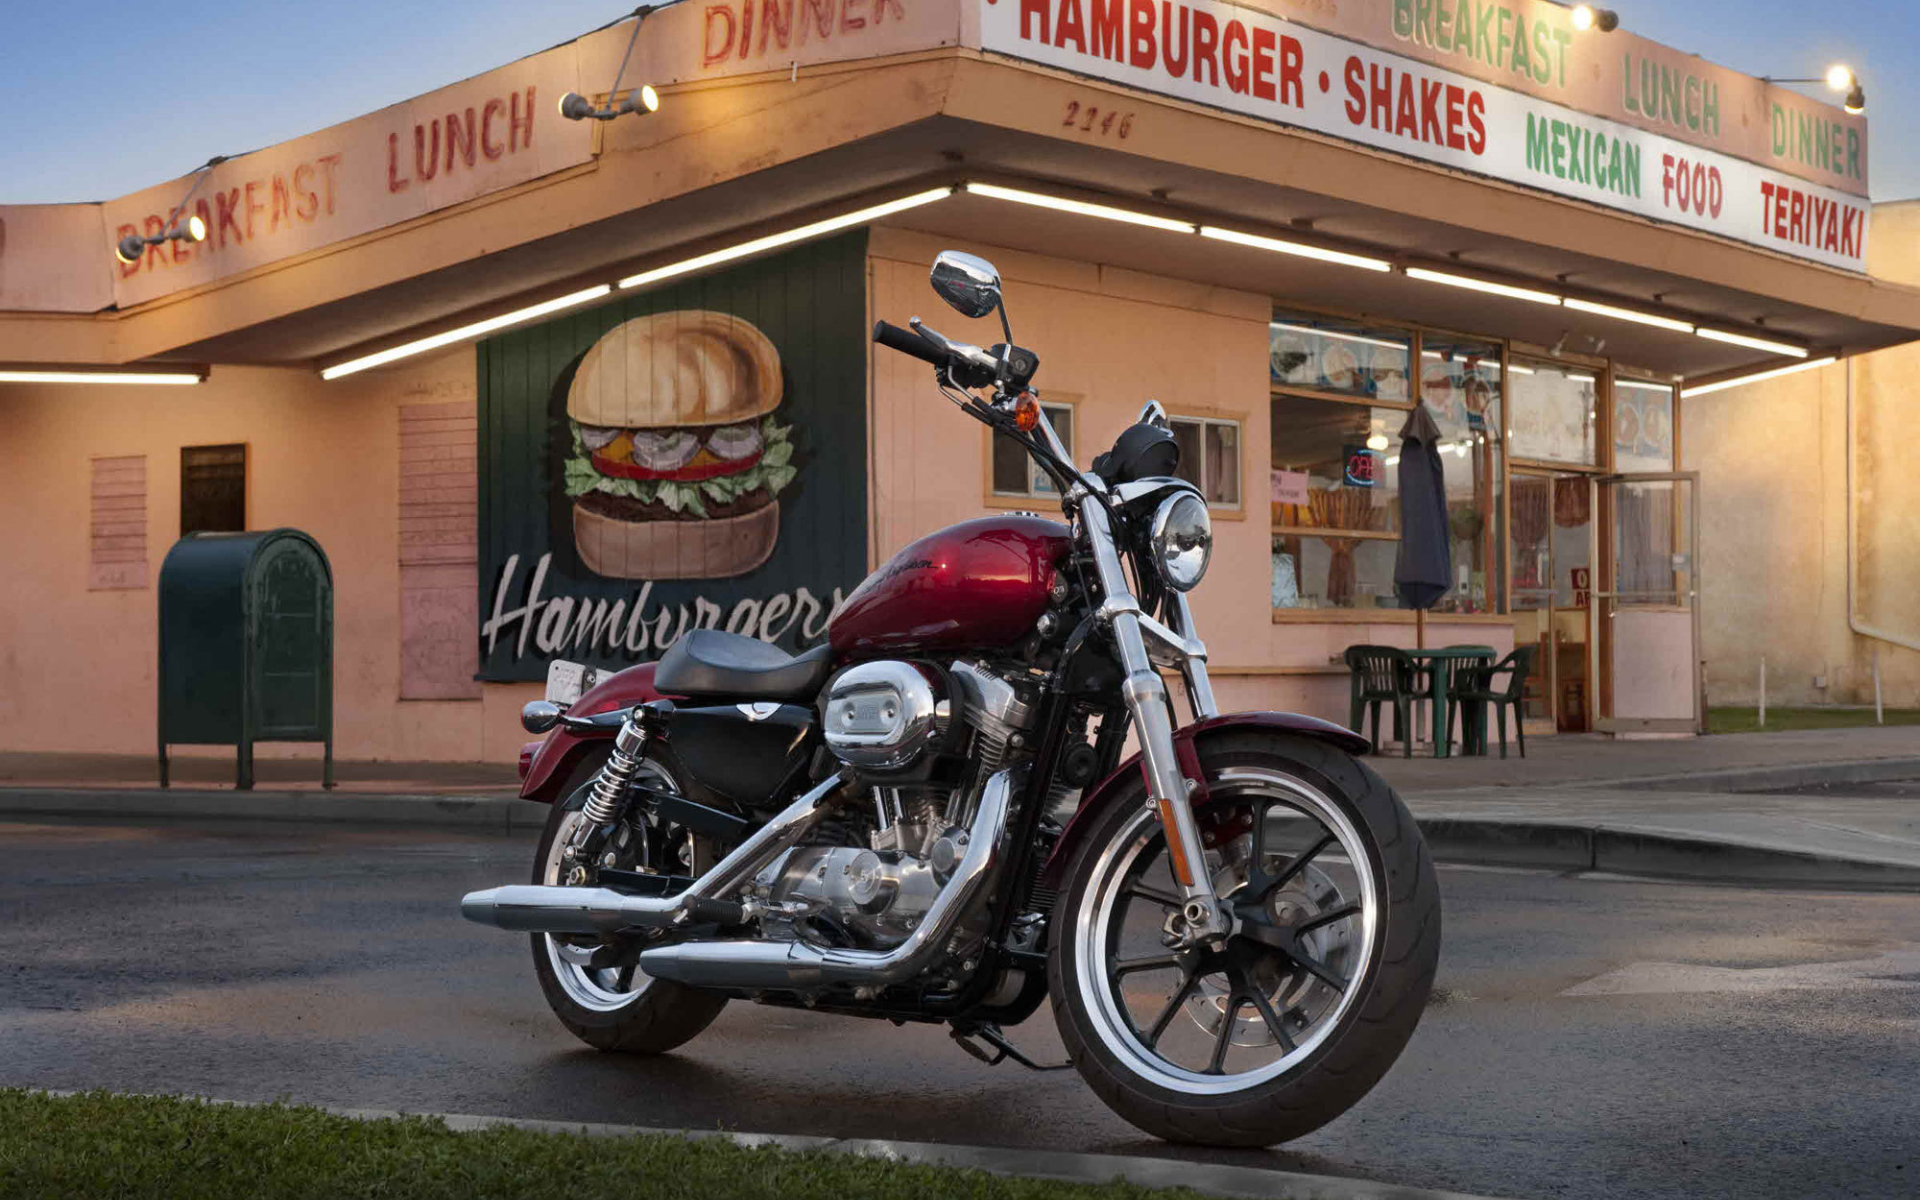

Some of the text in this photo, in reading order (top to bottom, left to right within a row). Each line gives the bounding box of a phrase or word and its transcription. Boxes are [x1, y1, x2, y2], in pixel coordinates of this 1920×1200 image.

[388, 86, 536, 193] LUNCH
[1019, 0, 1864, 259] HAMBURGER SHAKES MEXICAN FOOD TERIYAKI
[1391, 0, 1861, 180] BREAKFAST LUNCH DINNER
